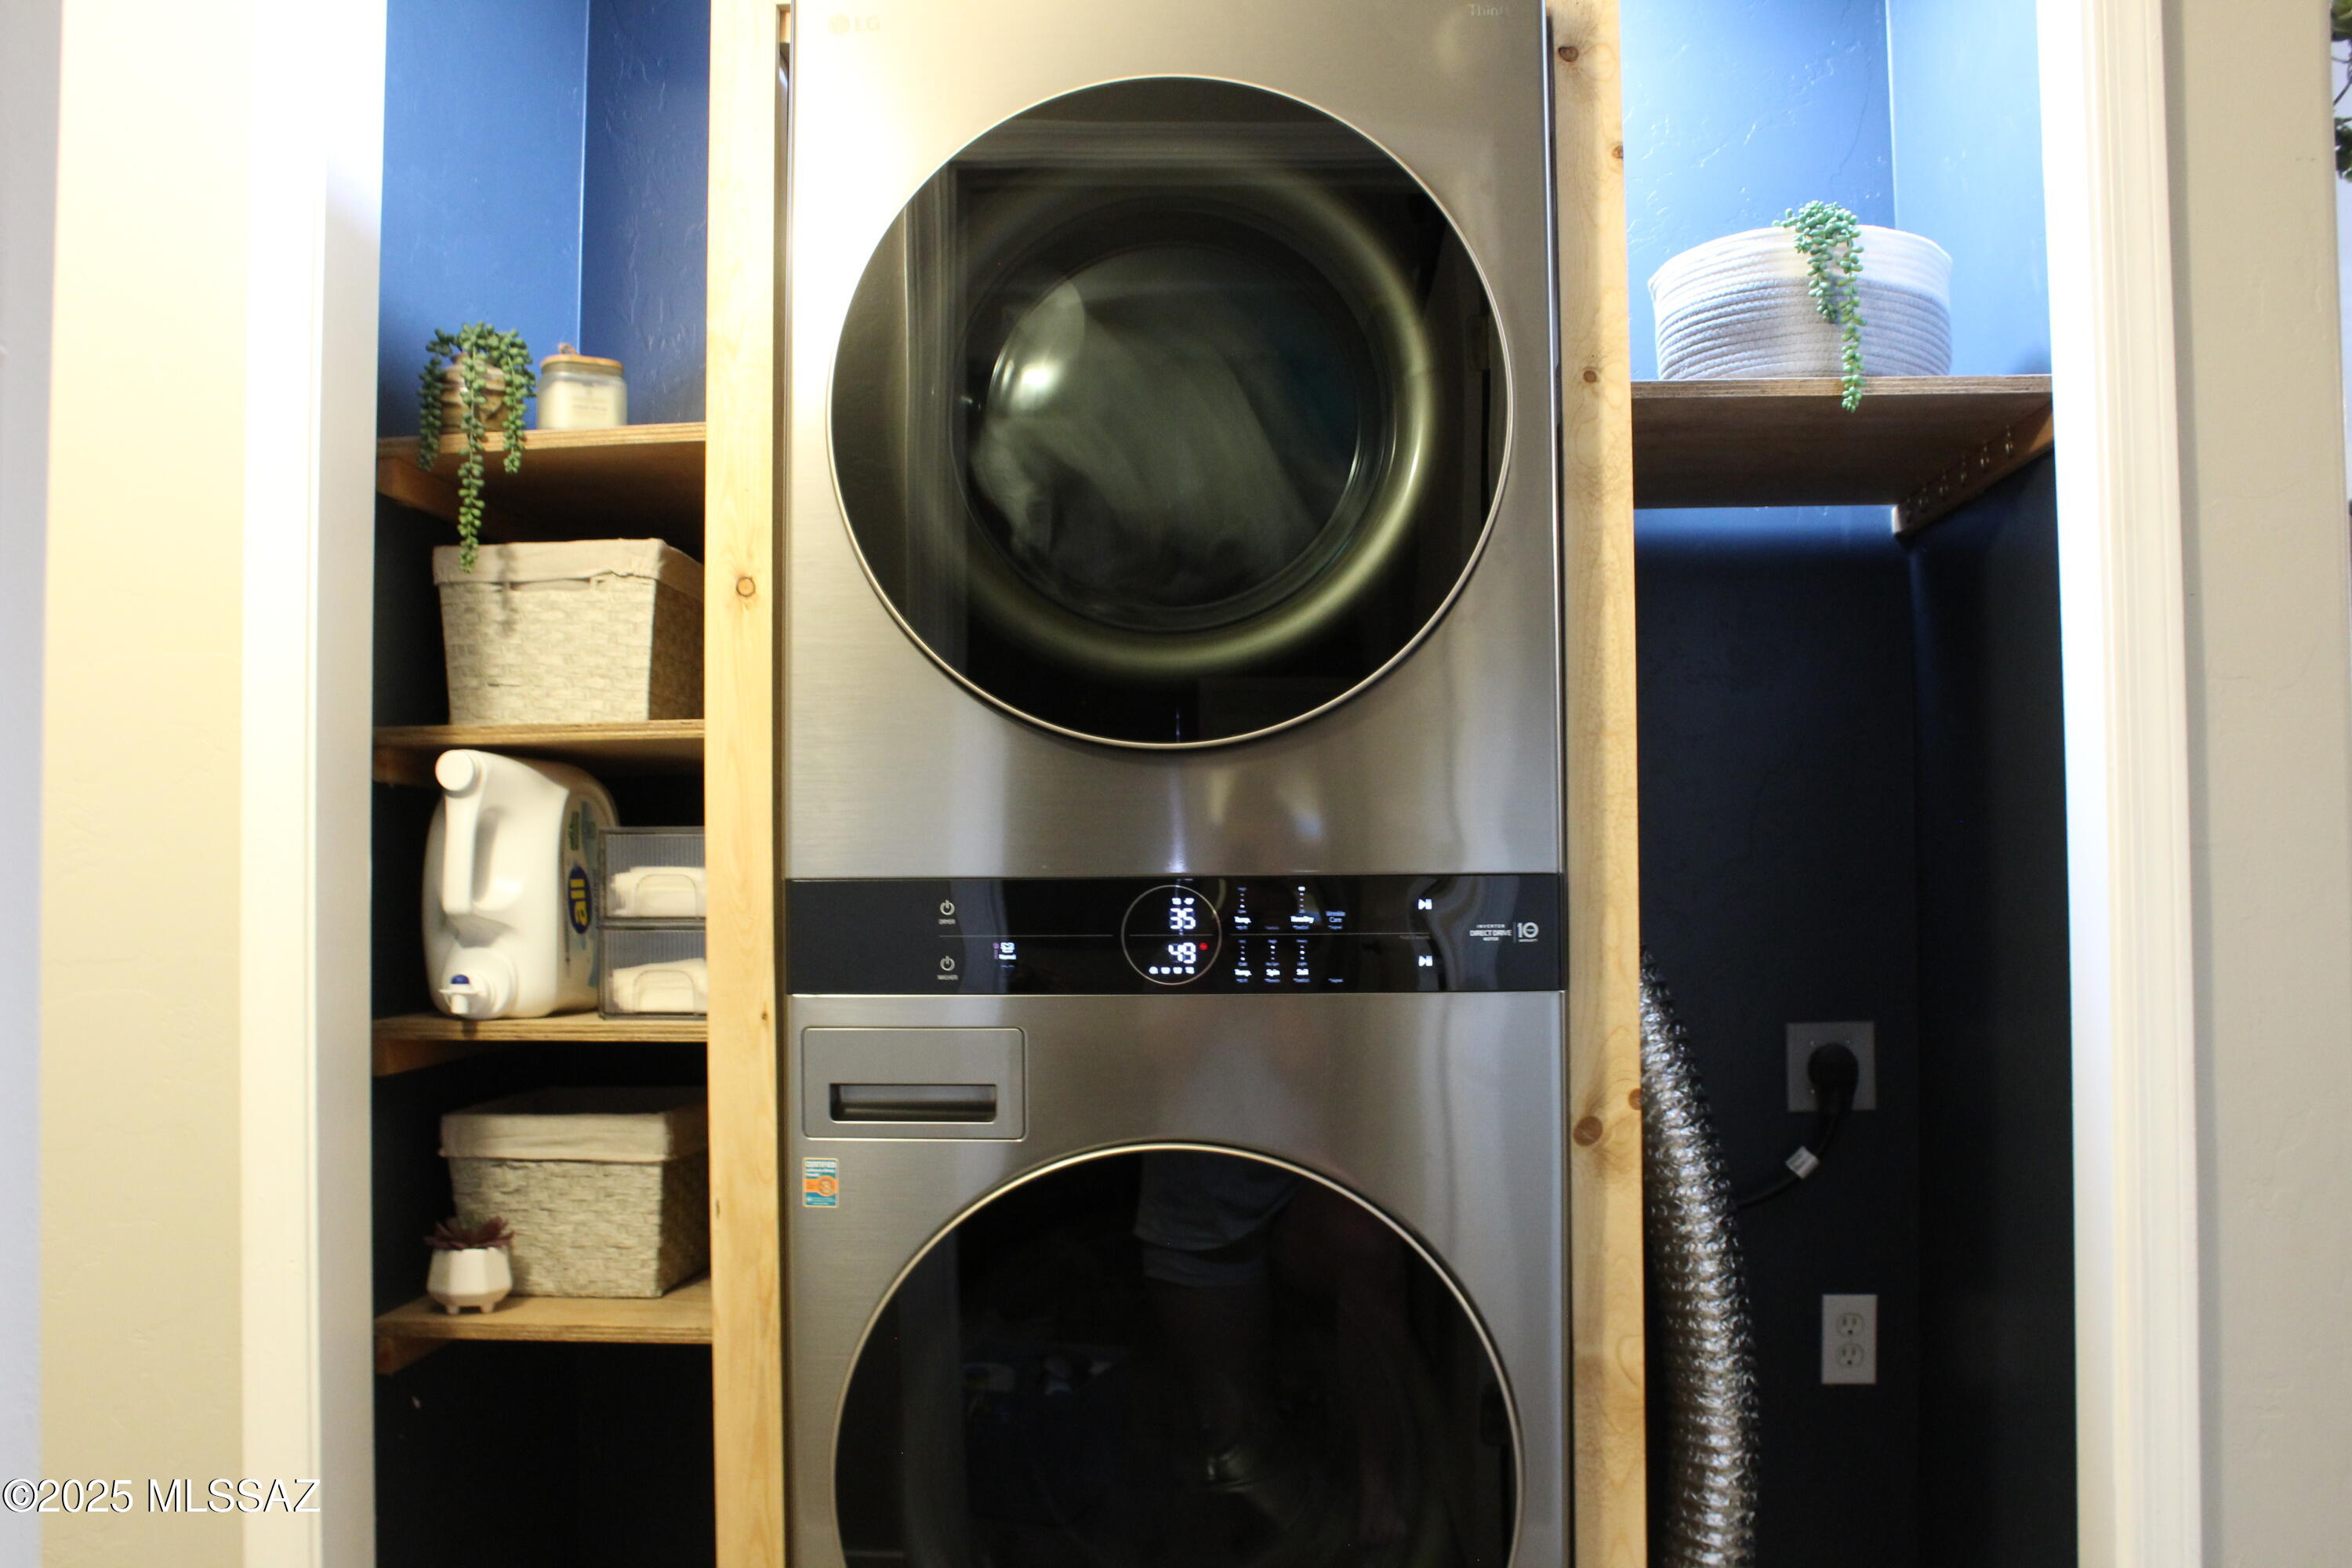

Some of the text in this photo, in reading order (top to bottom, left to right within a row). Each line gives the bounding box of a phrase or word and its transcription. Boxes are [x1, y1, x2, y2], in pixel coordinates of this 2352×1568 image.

[1468, 3, 1509, 16] Thin
[855, 16, 880, 32] LG
[1170, 907, 1196, 930] 35
[1168, 942, 1196, 964] 49
